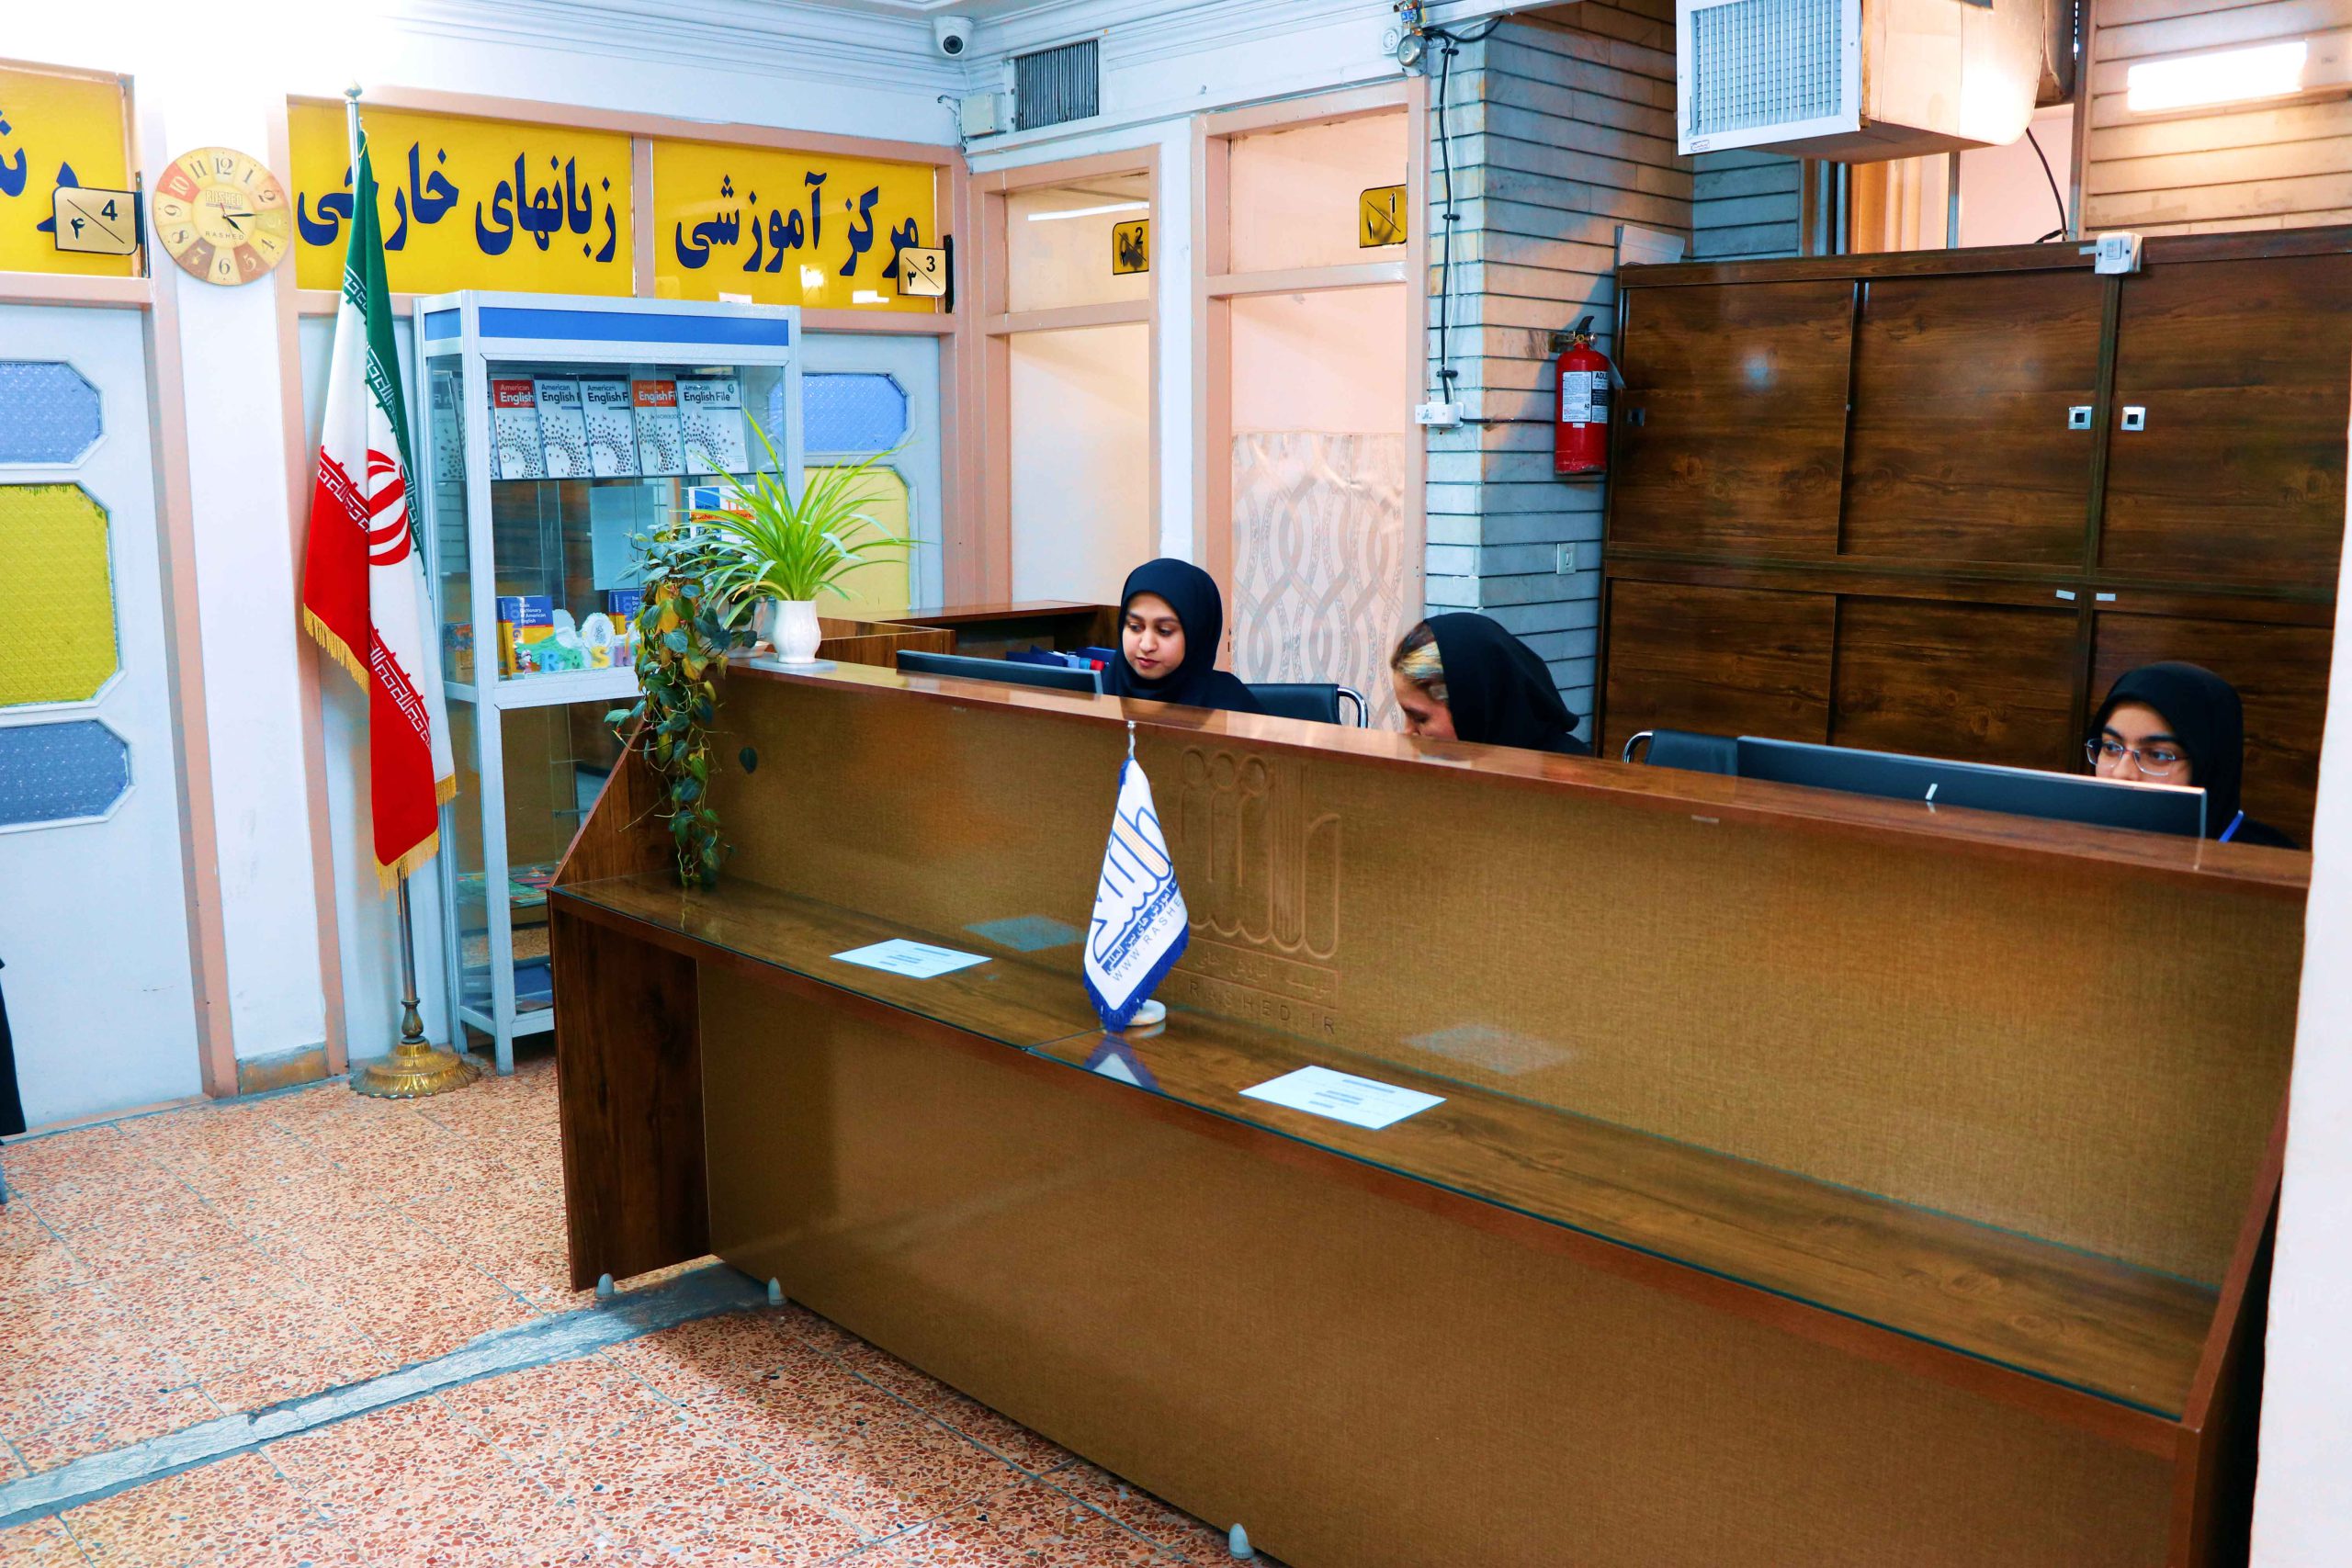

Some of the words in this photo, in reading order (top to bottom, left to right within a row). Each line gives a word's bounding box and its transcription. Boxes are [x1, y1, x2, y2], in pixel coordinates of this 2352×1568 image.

[189, 160, 208, 179] 11
[214, 157, 233, 175] 12
[243, 169, 254, 185] 1
[168, 175, 190, 196] 10
[258, 189, 276, 203] 2
[101, 199, 118, 221] 4
[164, 204, 181, 217] 9
[475, 152, 616, 263] زبانهای
[675, 171, 827, 273] آموزشی
[171, 230, 189, 244] 8
[205, 231, 244, 241] RASHED
[839, 186, 919, 278] مرکز
[1135, 226, 1144, 244] 2
[219, 258, 231, 275] 6
[243, 254, 257, 272] 5
[926, 255, 935, 272] 3
[907, 271, 917, 287] ۳
[500, 383, 530, 391] American
[500, 391, 534, 405] English
[541, 391, 575, 404] English
[587, 391, 622, 405] English
[639, 390, 668, 403] English
[684, 391, 716, 404] English
[716, 392, 731, 401] File
